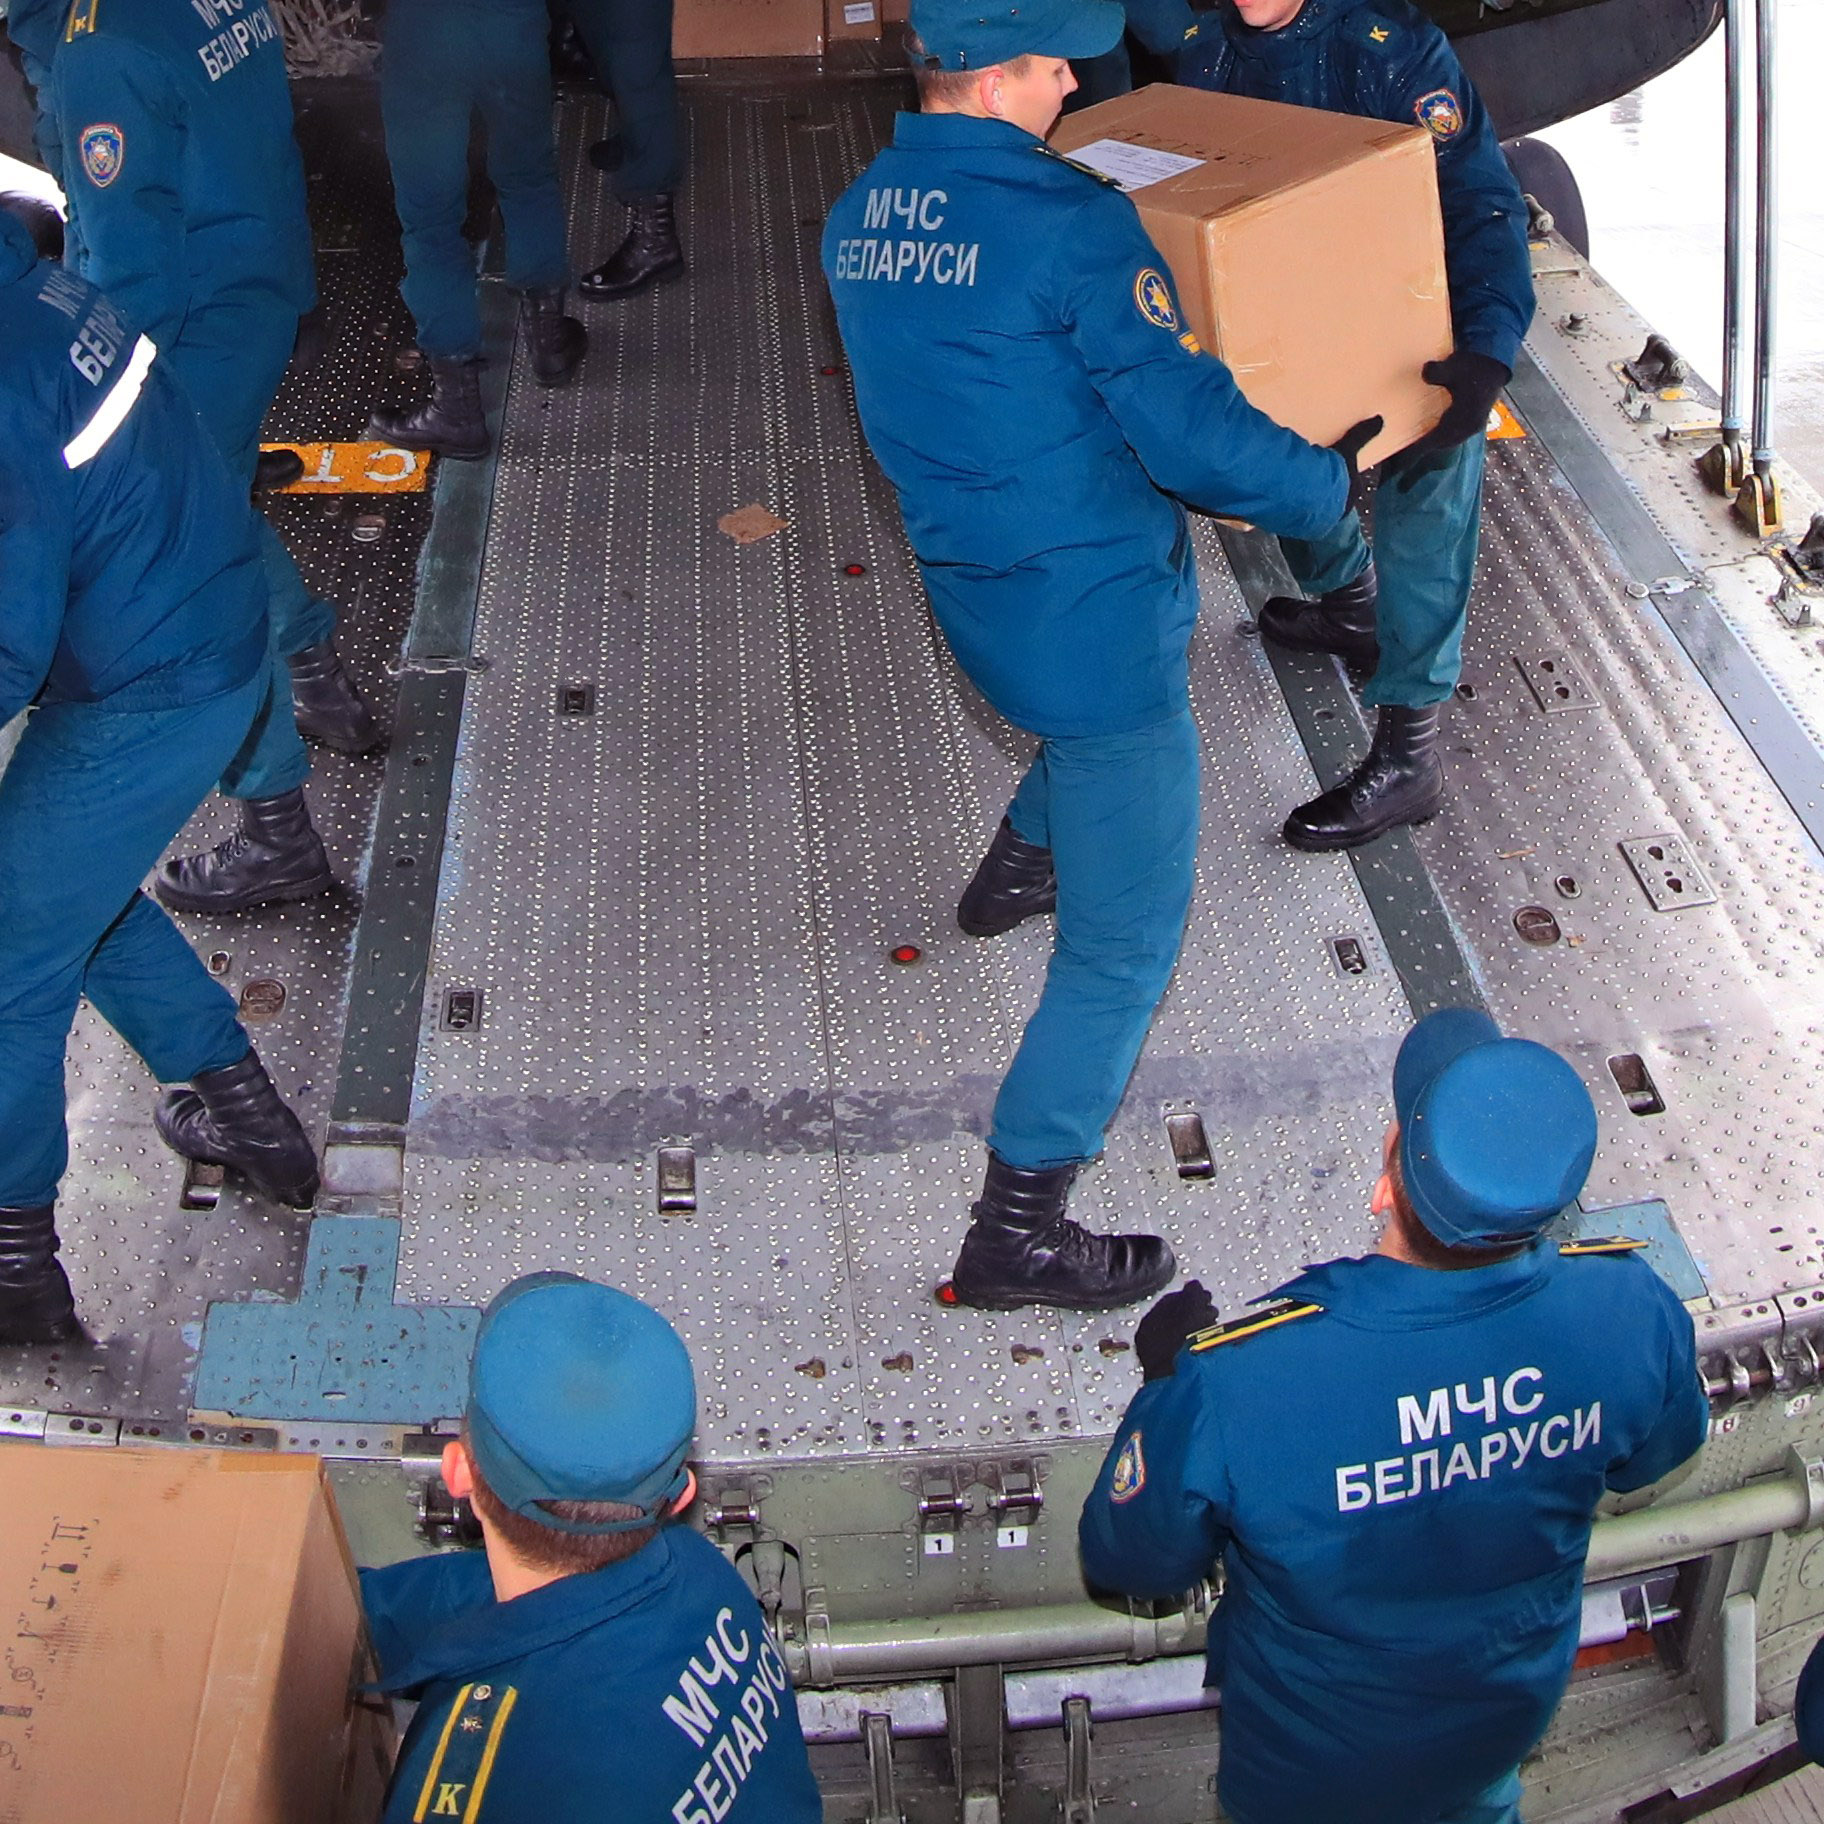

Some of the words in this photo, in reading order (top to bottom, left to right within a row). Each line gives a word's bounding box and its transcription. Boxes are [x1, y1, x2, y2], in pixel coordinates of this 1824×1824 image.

[198, 6, 278, 82] БЕЛАРУСИ
[1369, 25, 1390, 43] К
[863, 188, 947, 231] МЧС
[836, 239, 979, 287] БЕЛАРУСИ
[1397, 1366, 1544, 1445] МЧС
[1336, 1401, 1601, 1512] БЕЛАРУСИ
[934, 1538, 942, 1551] 1
[1009, 1531, 1015, 1544] 1
[662, 1606, 750, 1748] МЧС
[433, 1783, 465, 1815] К
